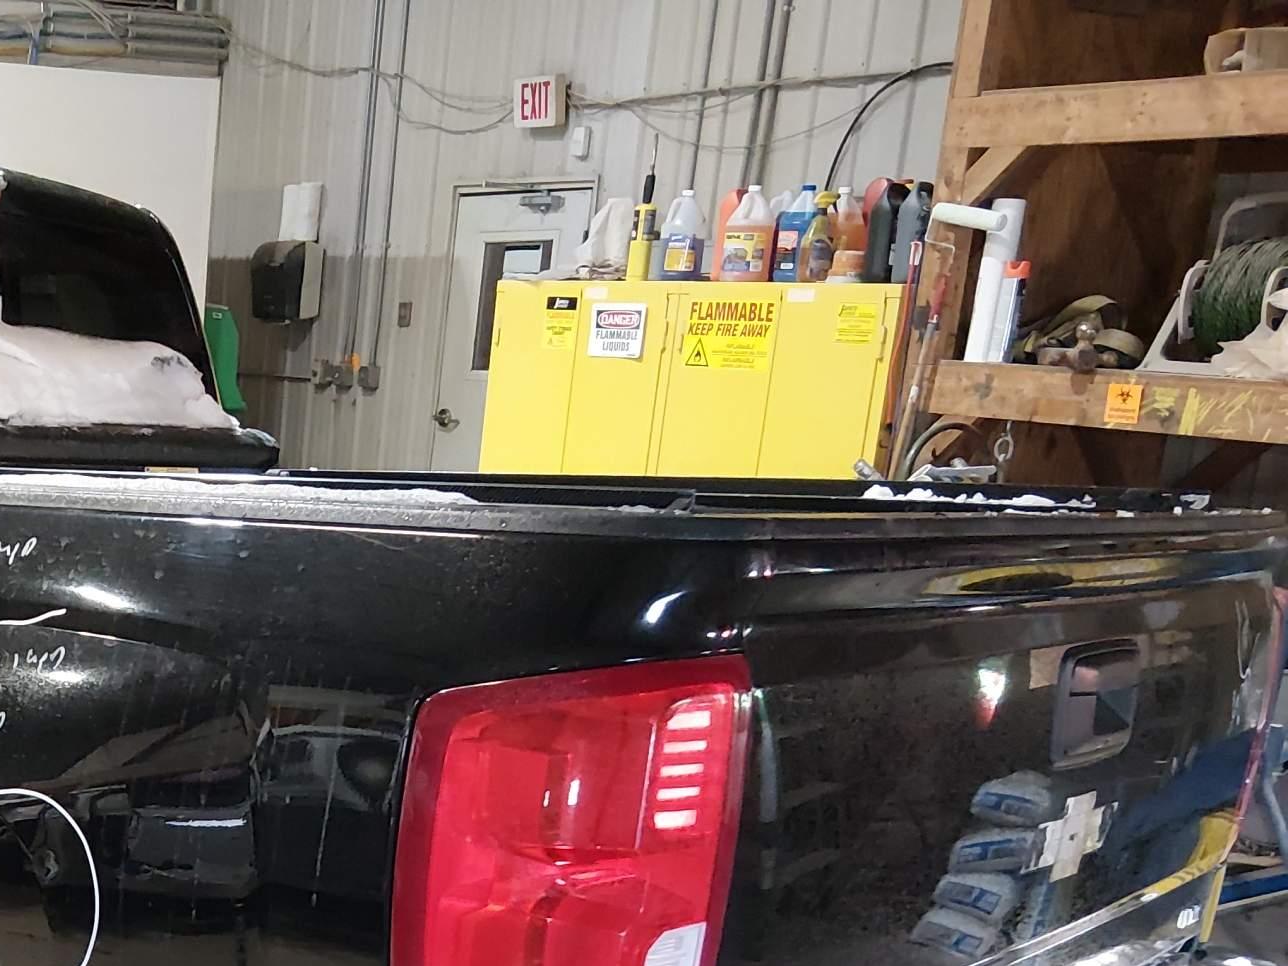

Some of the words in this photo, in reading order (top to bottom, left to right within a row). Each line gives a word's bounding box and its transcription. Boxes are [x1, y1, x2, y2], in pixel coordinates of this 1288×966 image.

[521, 80, 551, 121] EXIT
[600, 311, 640, 326] DANGER
[690, 301, 775, 322] FLAMMABLE
[596, 329, 638, 341] FLAMMABLE
[688, 323, 713, 336] KEEP
[716, 323, 739, 337] FIRE
[740, 324, 771, 338] AWAY
[602, 341, 630, 352] LIQUIDS
